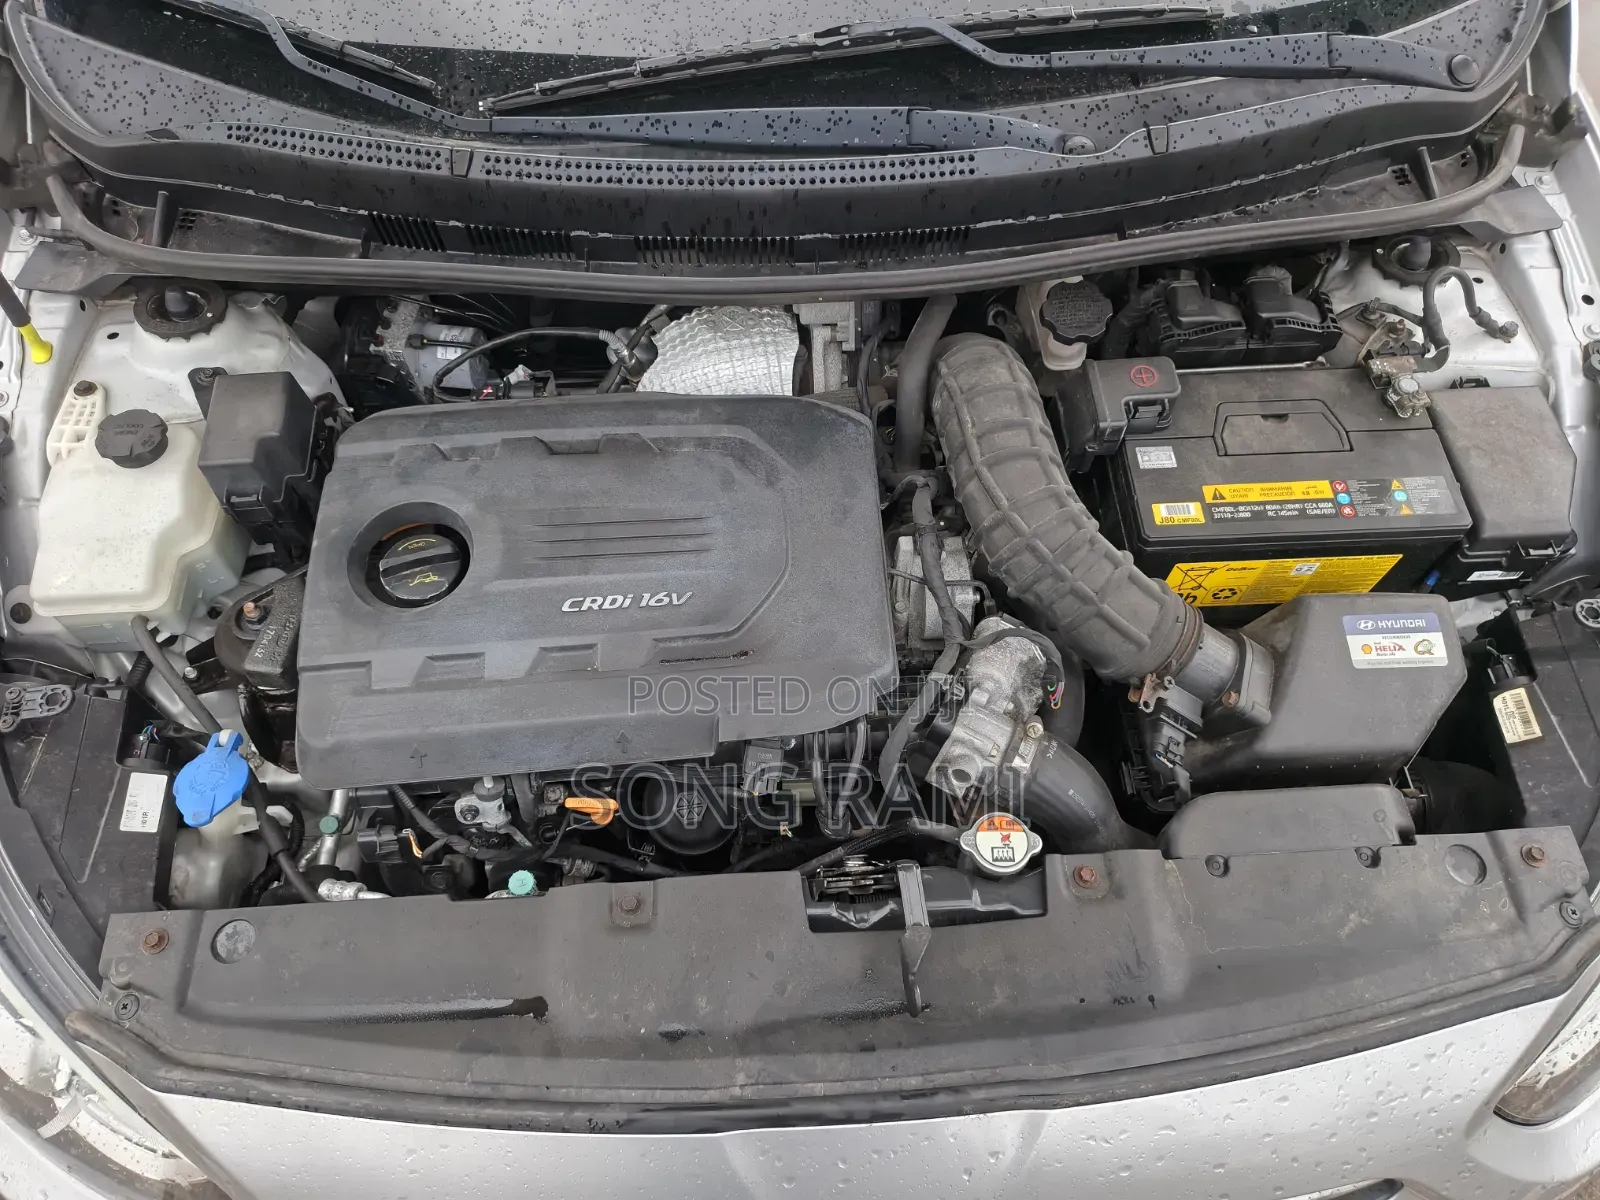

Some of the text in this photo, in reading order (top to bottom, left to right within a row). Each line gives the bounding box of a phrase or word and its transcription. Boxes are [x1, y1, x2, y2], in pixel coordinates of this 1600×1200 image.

[1159, 516, 1176, 524] J80
[561, 591, 693, 612] CRDi 16V
[1377, 618, 1427, 629] HYUNDAI
[1375, 643, 1406, 653] HELIX
